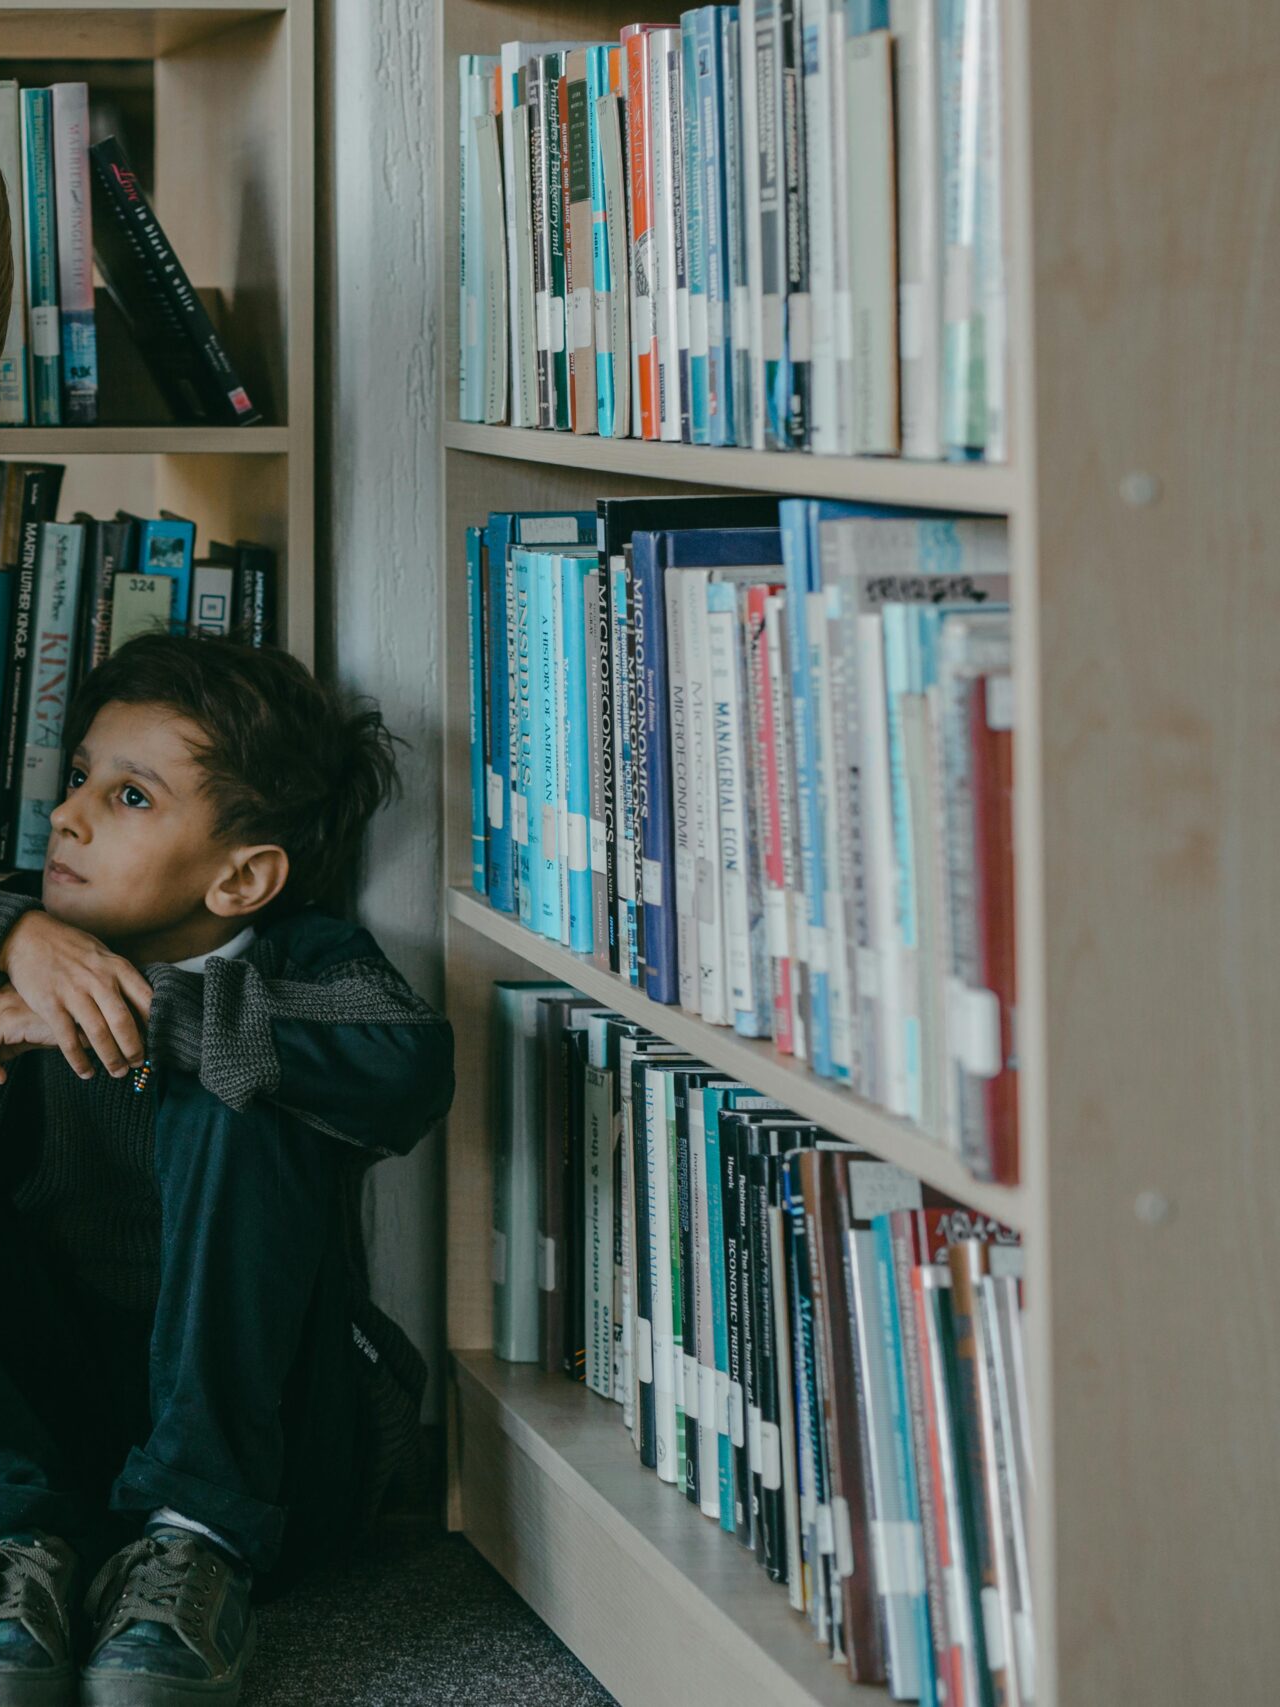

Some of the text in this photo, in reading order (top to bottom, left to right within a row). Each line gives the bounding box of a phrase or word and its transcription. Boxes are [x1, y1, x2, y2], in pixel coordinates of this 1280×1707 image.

[549, 77, 562, 256] Principles of Budgetary and
[765, 49, 775, 182] INTERNATIONAL
[68, 123, 83, 256] MARRIED SINGLE
[110, 163, 196, 312] Love in black white
[692, 147, 704, 286] Political Economy
[17, 522, 36, 610] MARTIN LUTHER
[130, 579, 155, 592] 324
[542, 616, 548, 624] A
[35, 630, 68, 723] KING
[518, 589, 532, 792] INSIDE U.S.
[544, 697, 551, 718] OF
[591, 681, 599, 748] Economics
[598, 584, 614, 842] MICROECONOMICS
[621, 624, 633, 809] Economic forecasting: HOLDEN,
[633, 578, 648, 818] MICROECONOMICS
[544, 722, 552, 800] AMERICAN
[593, 751, 600, 765] of
[627, 656, 642, 906] MICROECONOMICS
[714, 702, 736, 814] MANAGERIAL
[644, 1087, 657, 1225] BEYOND THE
[679, 1137, 688, 1232] ENTREPRENEURSHIP
[591, 1115, 600, 1387] Business enterprises & their
[727, 1155, 738, 1321] Hayek ECONOMIC
[739, 1174, 747, 1226] Robinson
[743, 1270, 751, 1339] International
[759, 1185, 768, 1262] DEPENDENCY
[602, 1305, 610, 1393] structure
[697, 1296, 702, 1309] in
